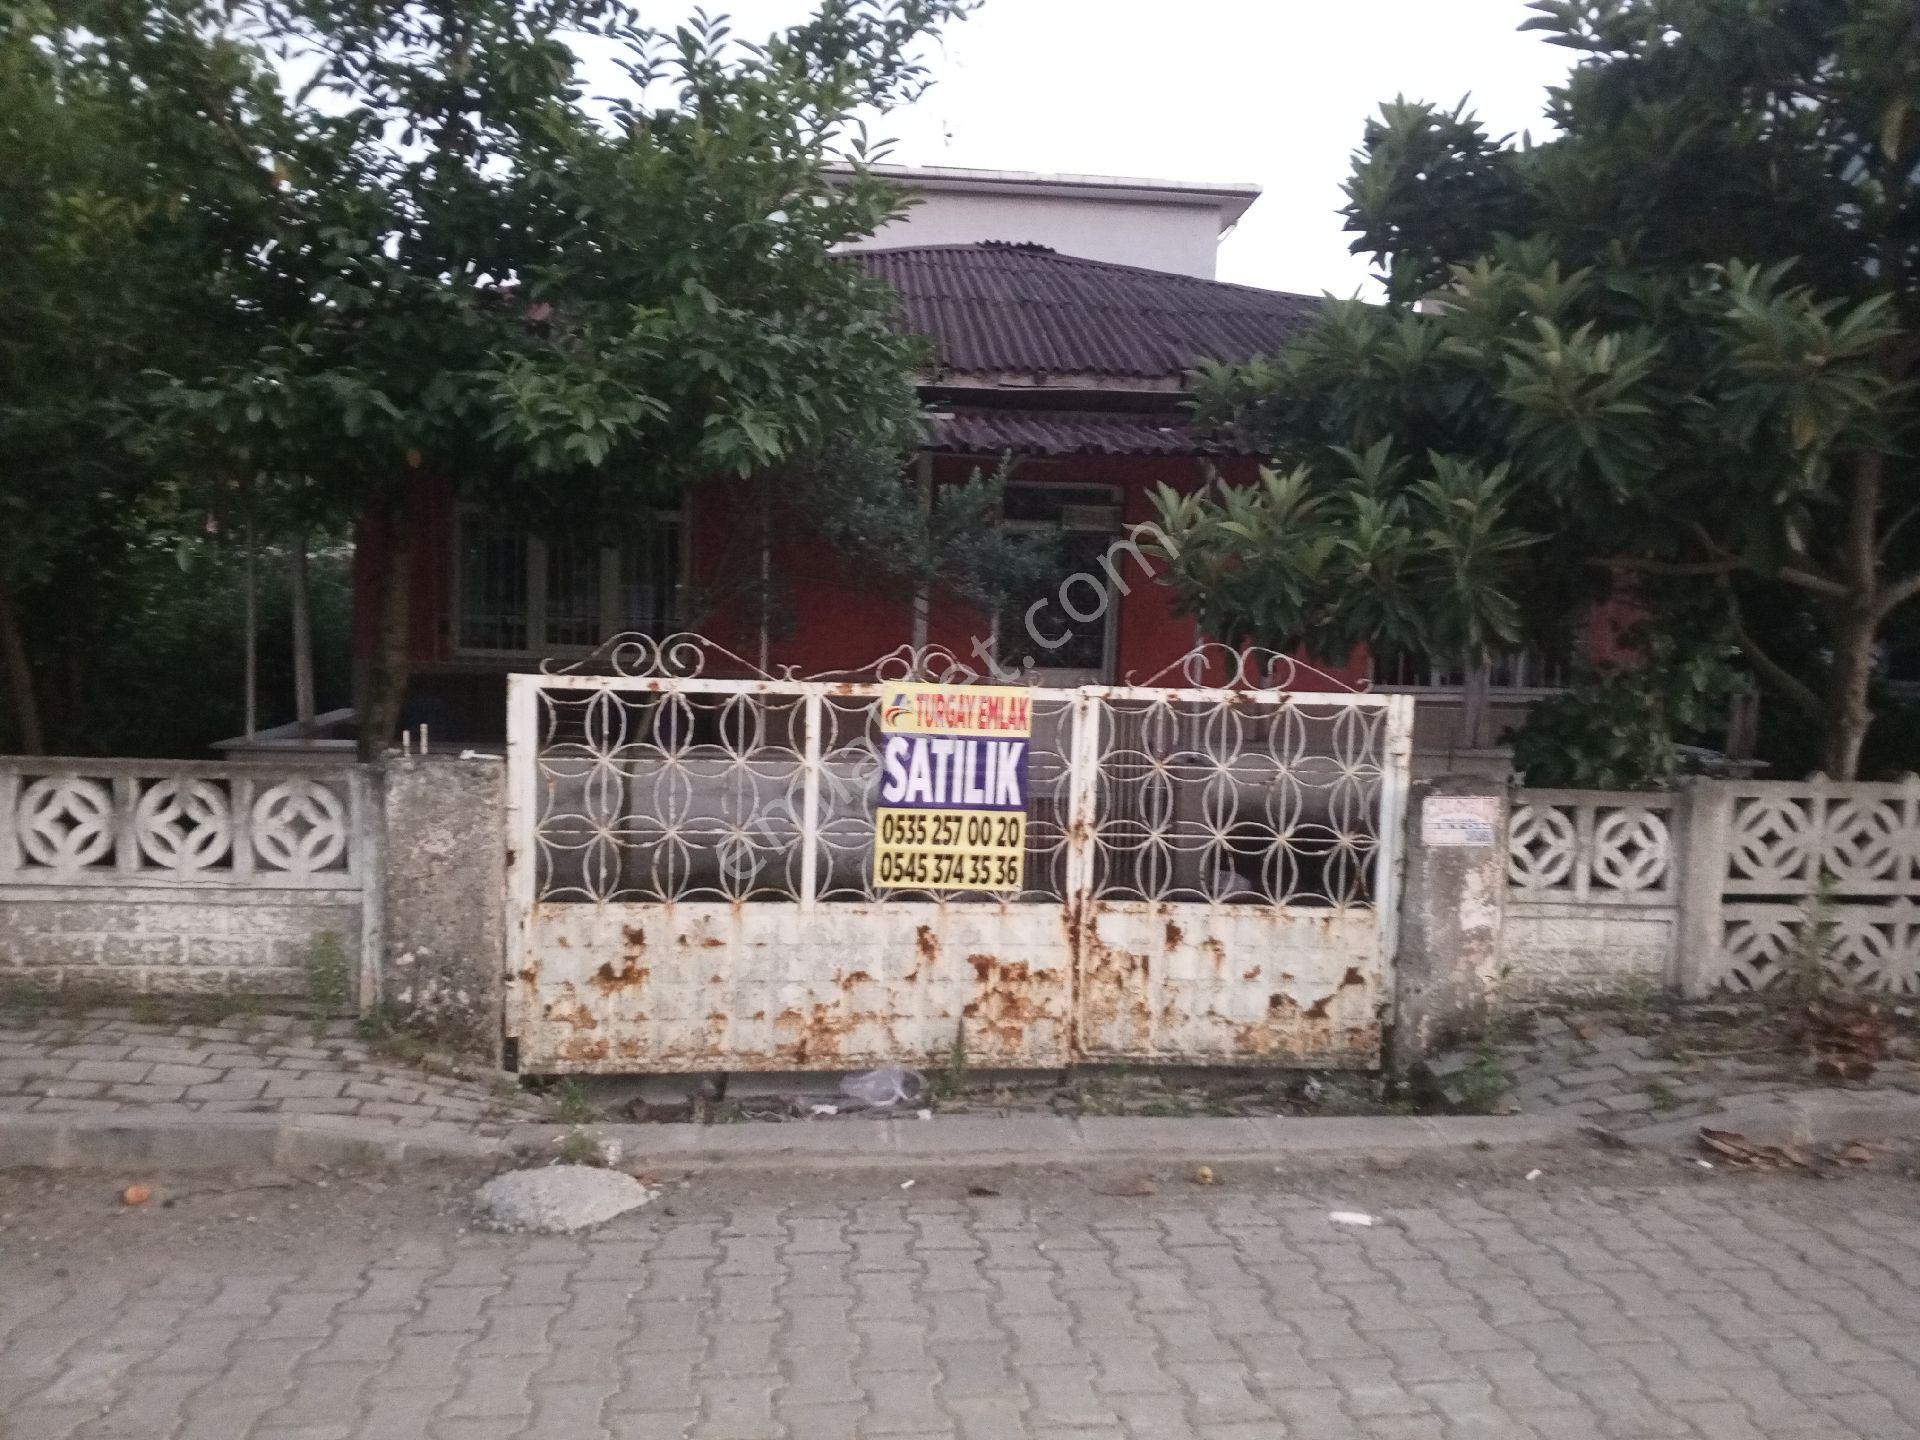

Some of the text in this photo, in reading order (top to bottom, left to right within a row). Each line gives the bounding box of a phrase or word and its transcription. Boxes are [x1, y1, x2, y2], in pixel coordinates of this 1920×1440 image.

[916, 693, 1030, 731] TURGAY EMLAK
[882, 736, 1025, 806] SATILIK
[882, 813, 1019, 848] 0535 257 00 20
[880, 851, 1018, 885] 0545 374 35 36
